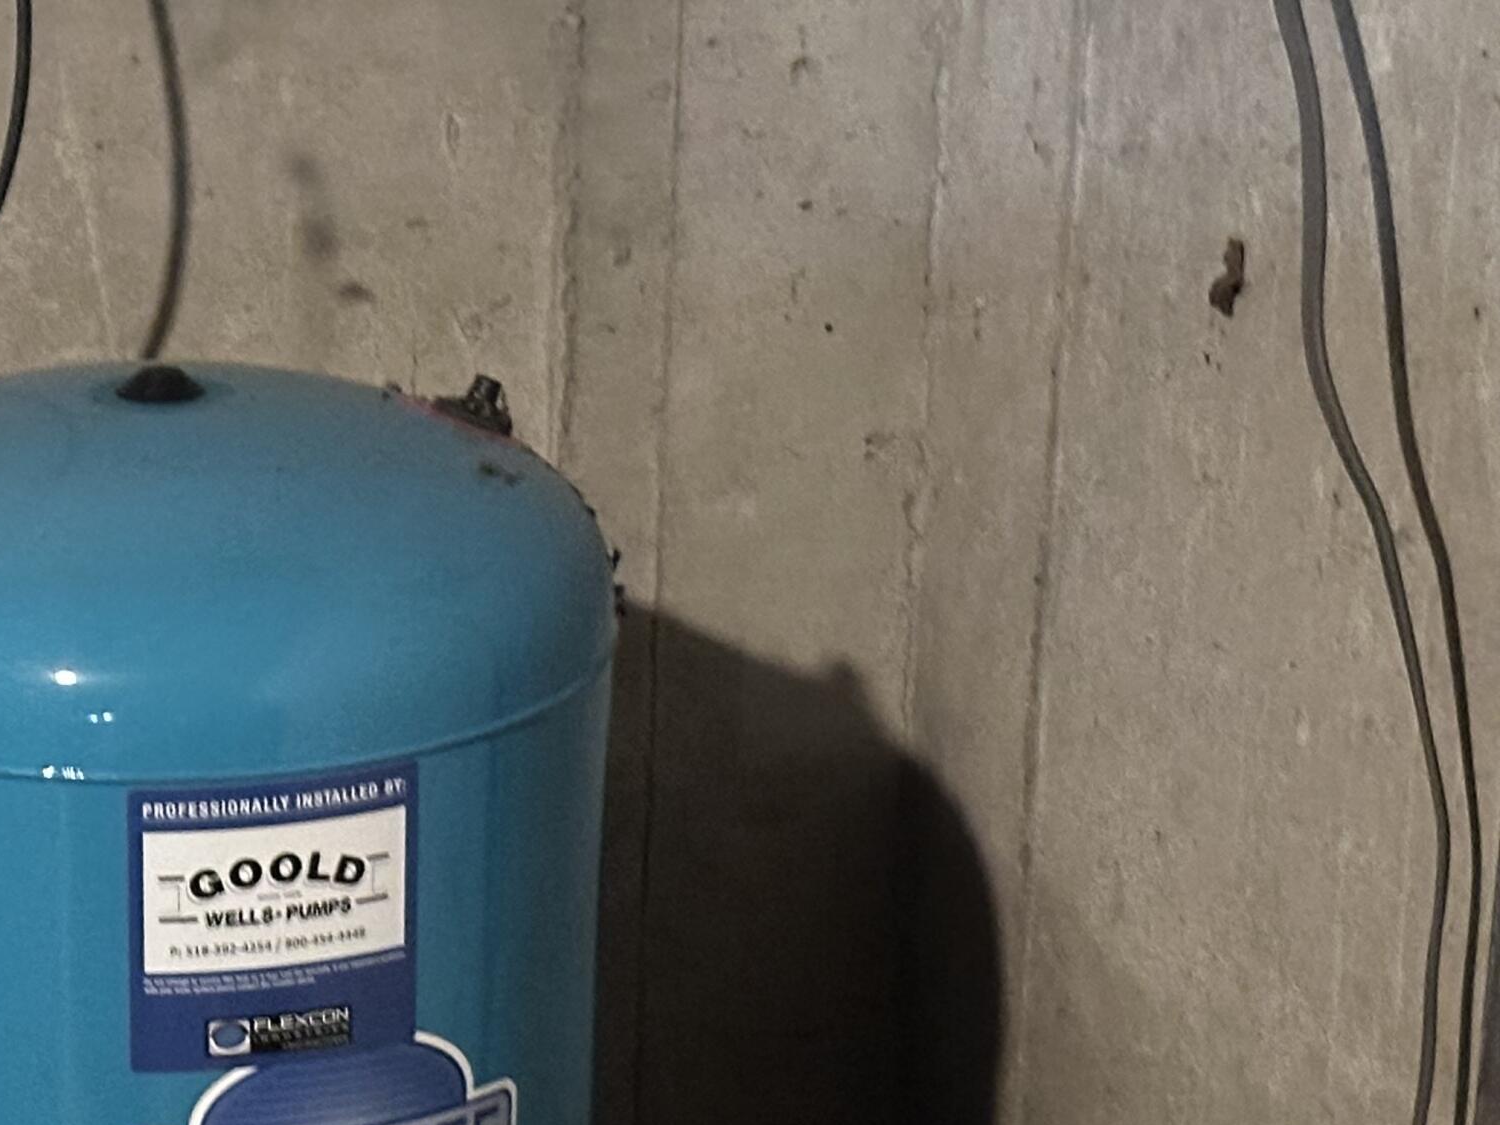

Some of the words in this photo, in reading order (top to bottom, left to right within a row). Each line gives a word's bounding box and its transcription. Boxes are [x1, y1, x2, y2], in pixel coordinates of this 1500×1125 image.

[142, 795, 289, 820] PROFESSIONALLY
[296, 782, 378, 809] INSTALLED
[188, 851, 366, 899] GOOLD
